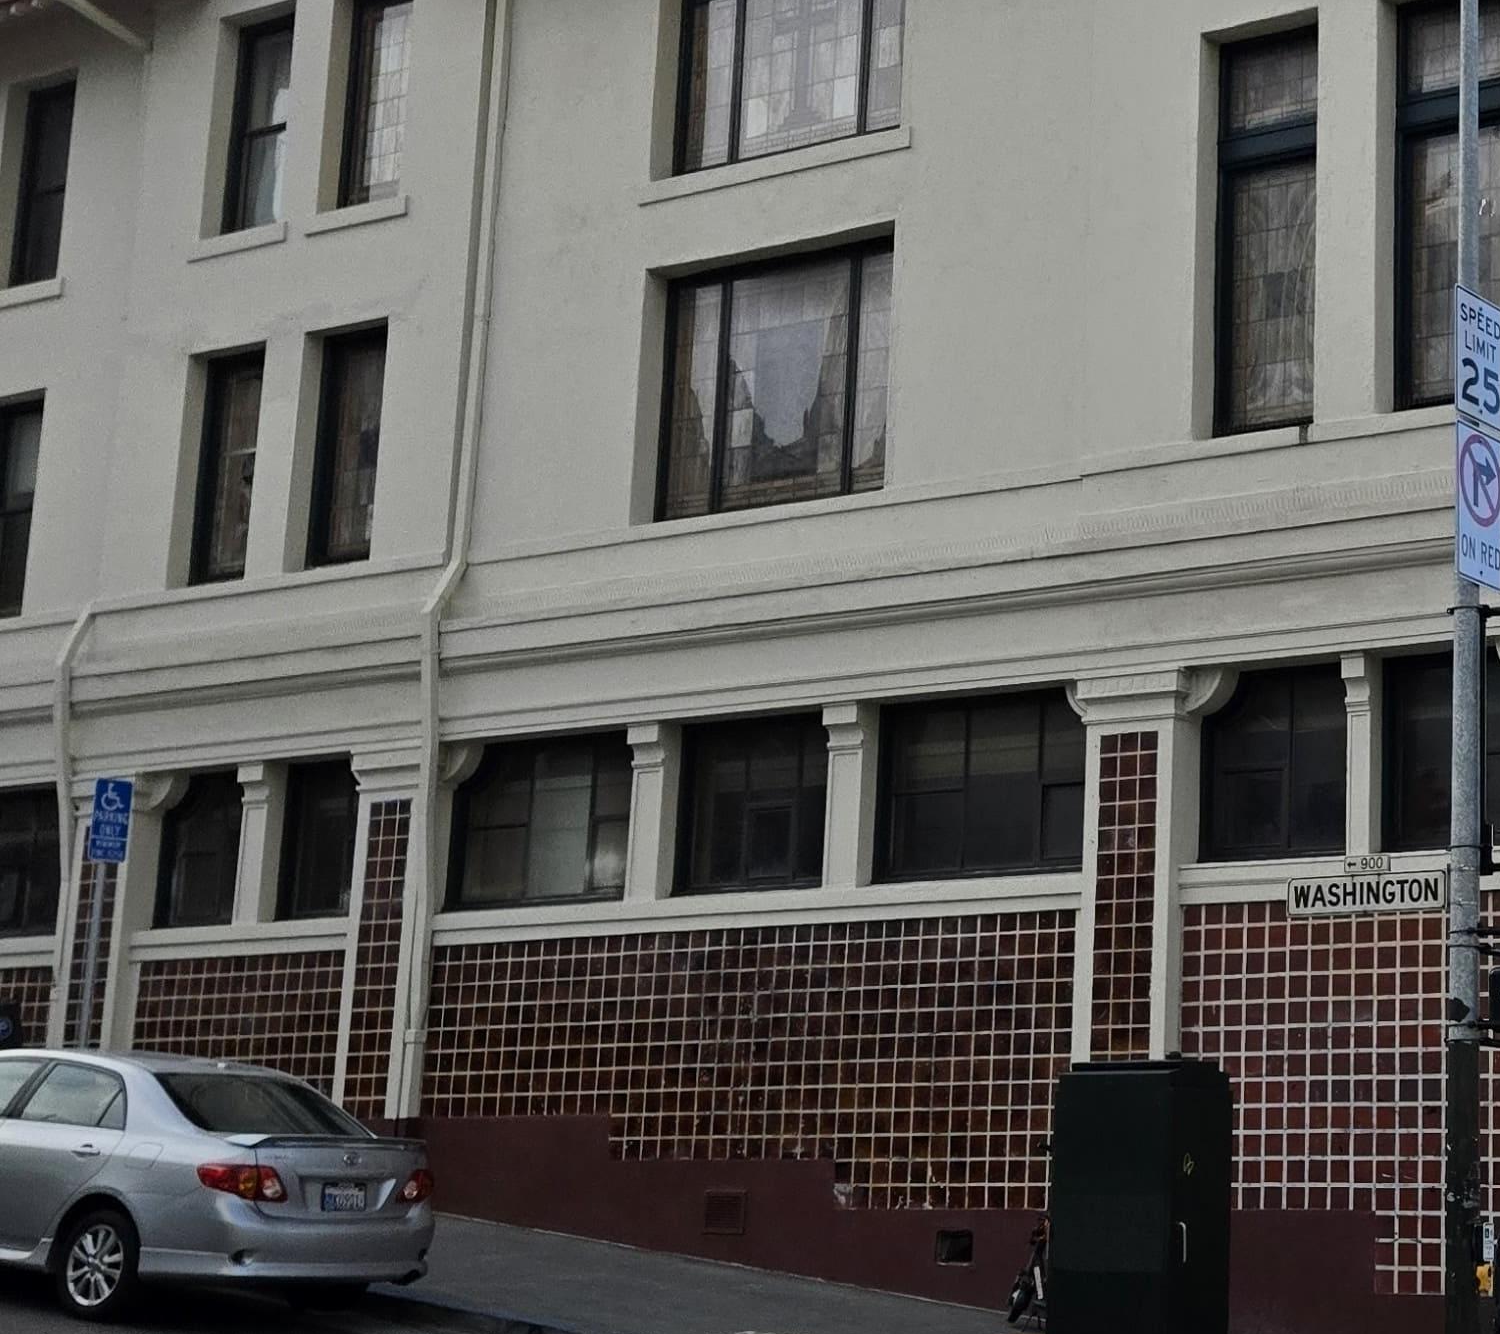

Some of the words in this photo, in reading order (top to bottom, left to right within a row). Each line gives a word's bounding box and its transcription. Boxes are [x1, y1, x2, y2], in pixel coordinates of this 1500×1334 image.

[1459, 303, 1500, 341] SPEED
[1464, 329, 1497, 364] LIMIT
[1461, 357, 1500, 416] 25
[1461, 533, 1476, 562] ON
[1481, 542, 1500, 571] RED
[99, 824, 120, 837] ONLY
[1360, 857, 1383, 870] 900
[1294, 877, 1439, 909] WASHINGTON
